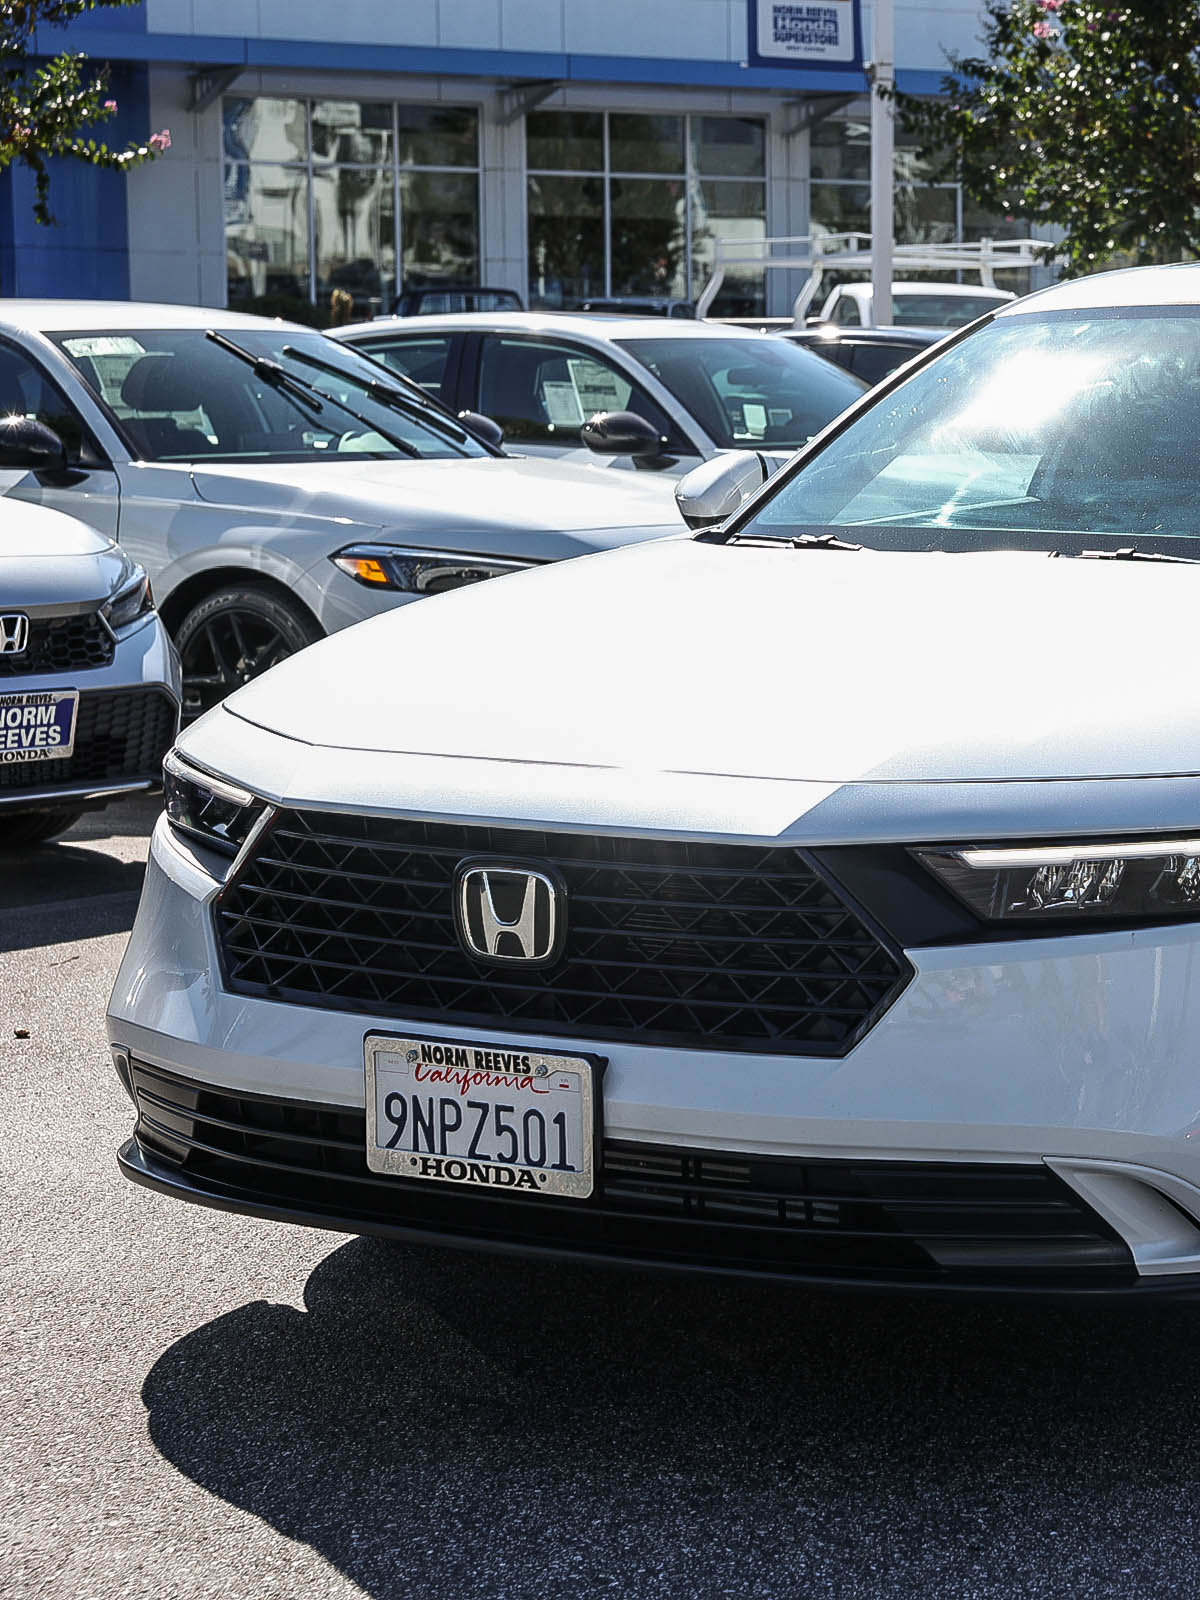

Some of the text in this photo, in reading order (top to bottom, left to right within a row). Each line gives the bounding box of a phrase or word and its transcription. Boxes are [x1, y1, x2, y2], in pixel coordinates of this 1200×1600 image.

[772, 5, 803, 16] NORM
[776, 16, 837, 32] Honda
[774, 32, 839, 46] SUPERSTORE
[25, 693, 53, 705] REEVES
[0, 725, 61, 749] EEVES
[420, 1044, 532, 1075] NORM REEVES
[413, 1063, 550, 1096] California
[384, 1091, 576, 1172] 9NPZ501
[418, 1156, 542, 1190] HONDA
